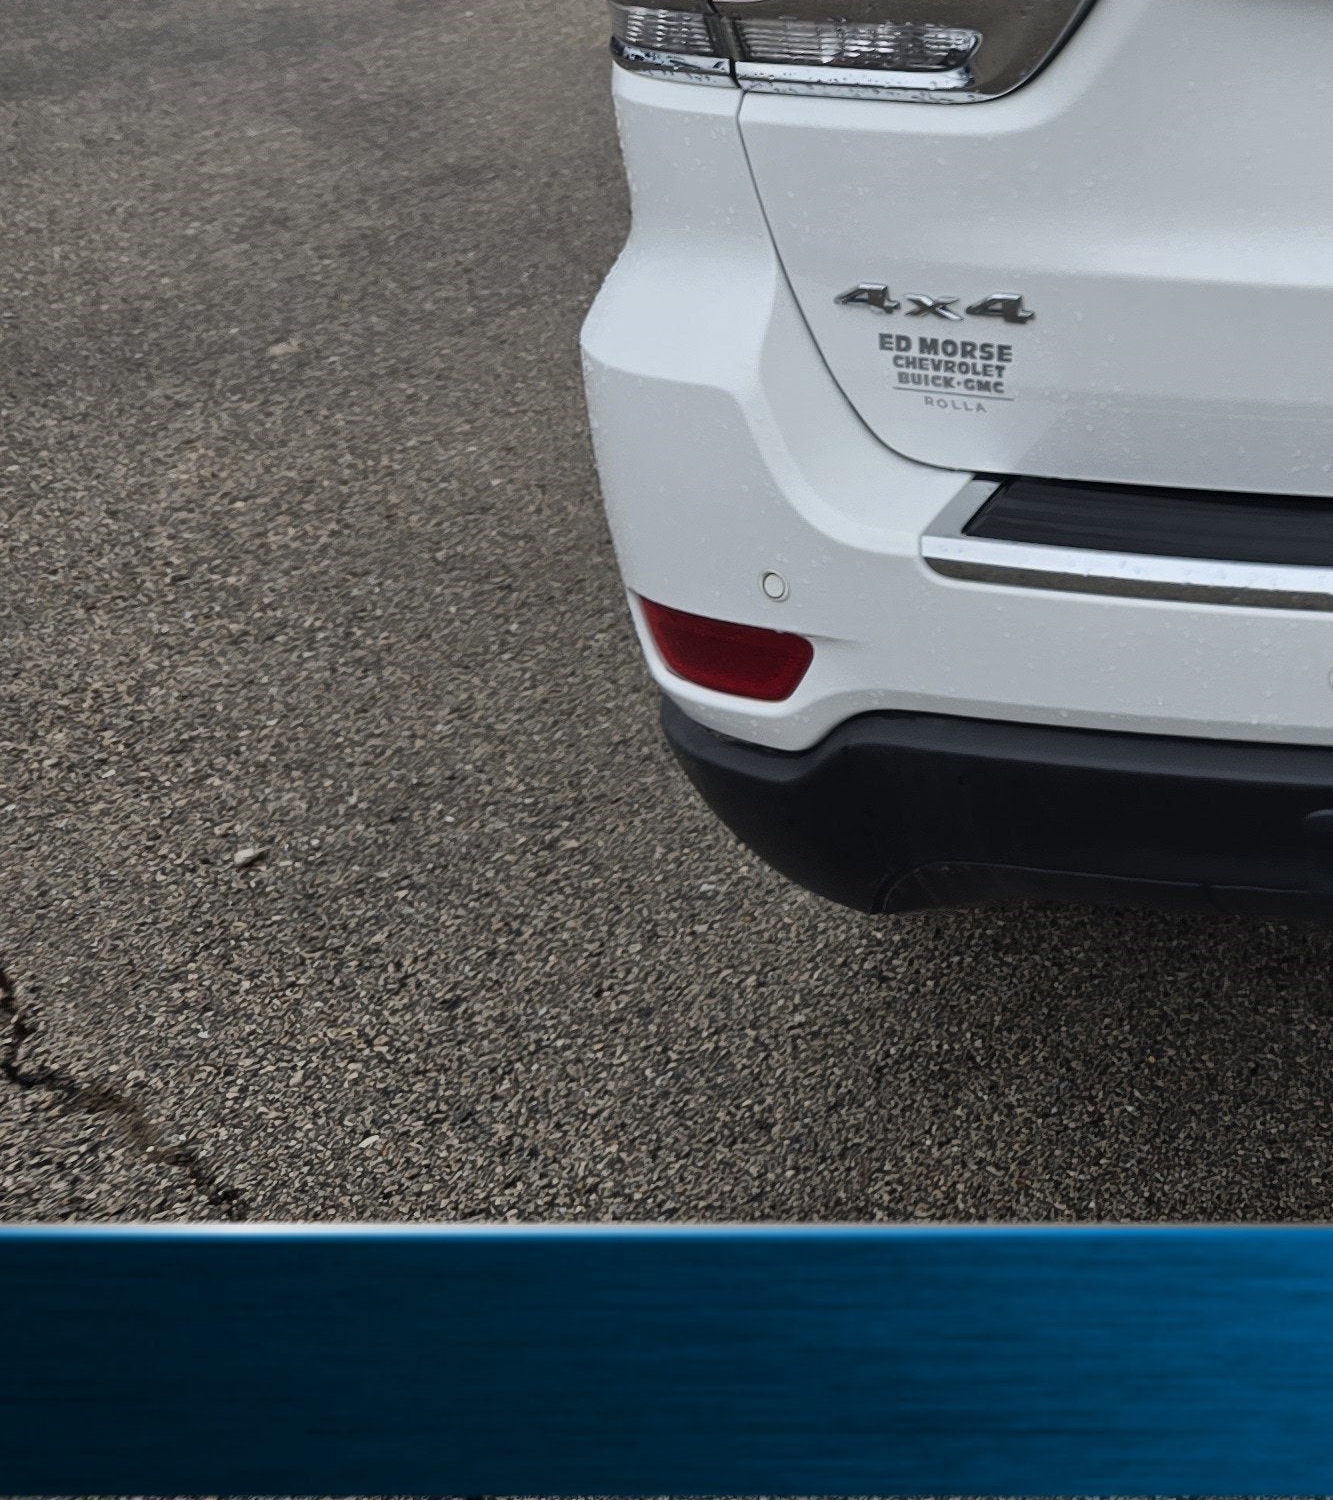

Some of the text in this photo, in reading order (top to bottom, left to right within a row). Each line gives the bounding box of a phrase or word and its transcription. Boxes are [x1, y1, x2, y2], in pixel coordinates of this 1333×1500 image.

[878, 332, 1013, 364] ED MORSE
[892, 354, 1007, 379] CHEVROLET
[923, 396, 987, 414] ROLLA
